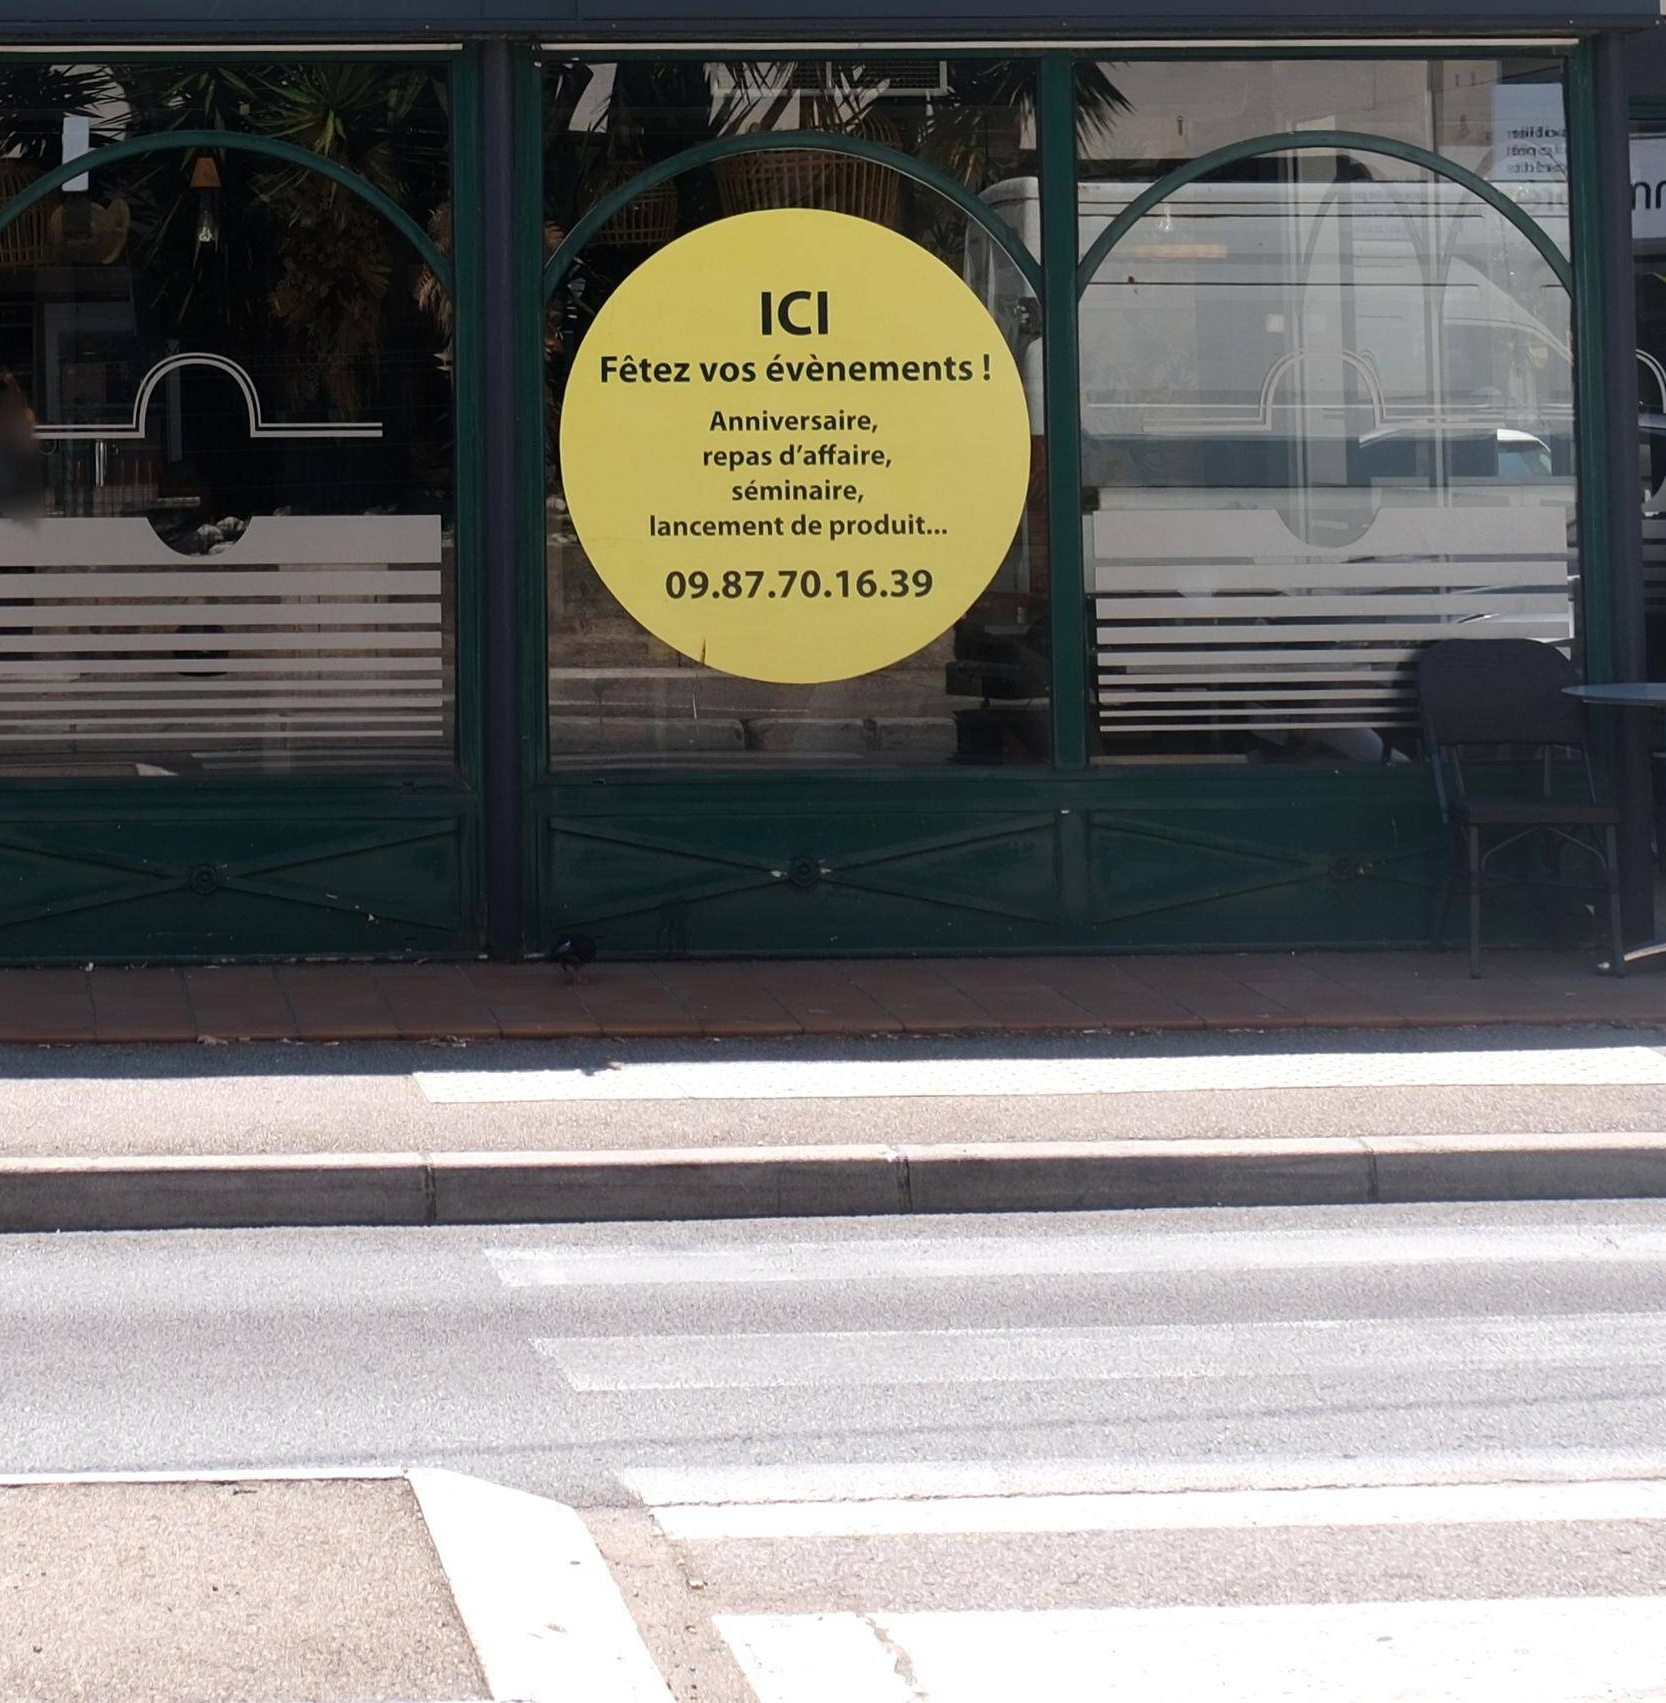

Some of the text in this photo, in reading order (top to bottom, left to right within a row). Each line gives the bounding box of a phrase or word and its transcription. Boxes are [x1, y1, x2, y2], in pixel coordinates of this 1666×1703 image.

[761, 291, 829, 336] ICI
[600, 356, 691, 383] Fêtez
[700, 362, 757, 383] vos
[765, 355, 974, 382] évènements
[709, 410, 879, 433] Anniversaire,
[703, 449, 773, 471] repas
[731, 479, 864, 503] séminaire,
[649, 513, 949, 541] lancement de produit...
[665, 569, 934, 600] 09.87.70.16.39
